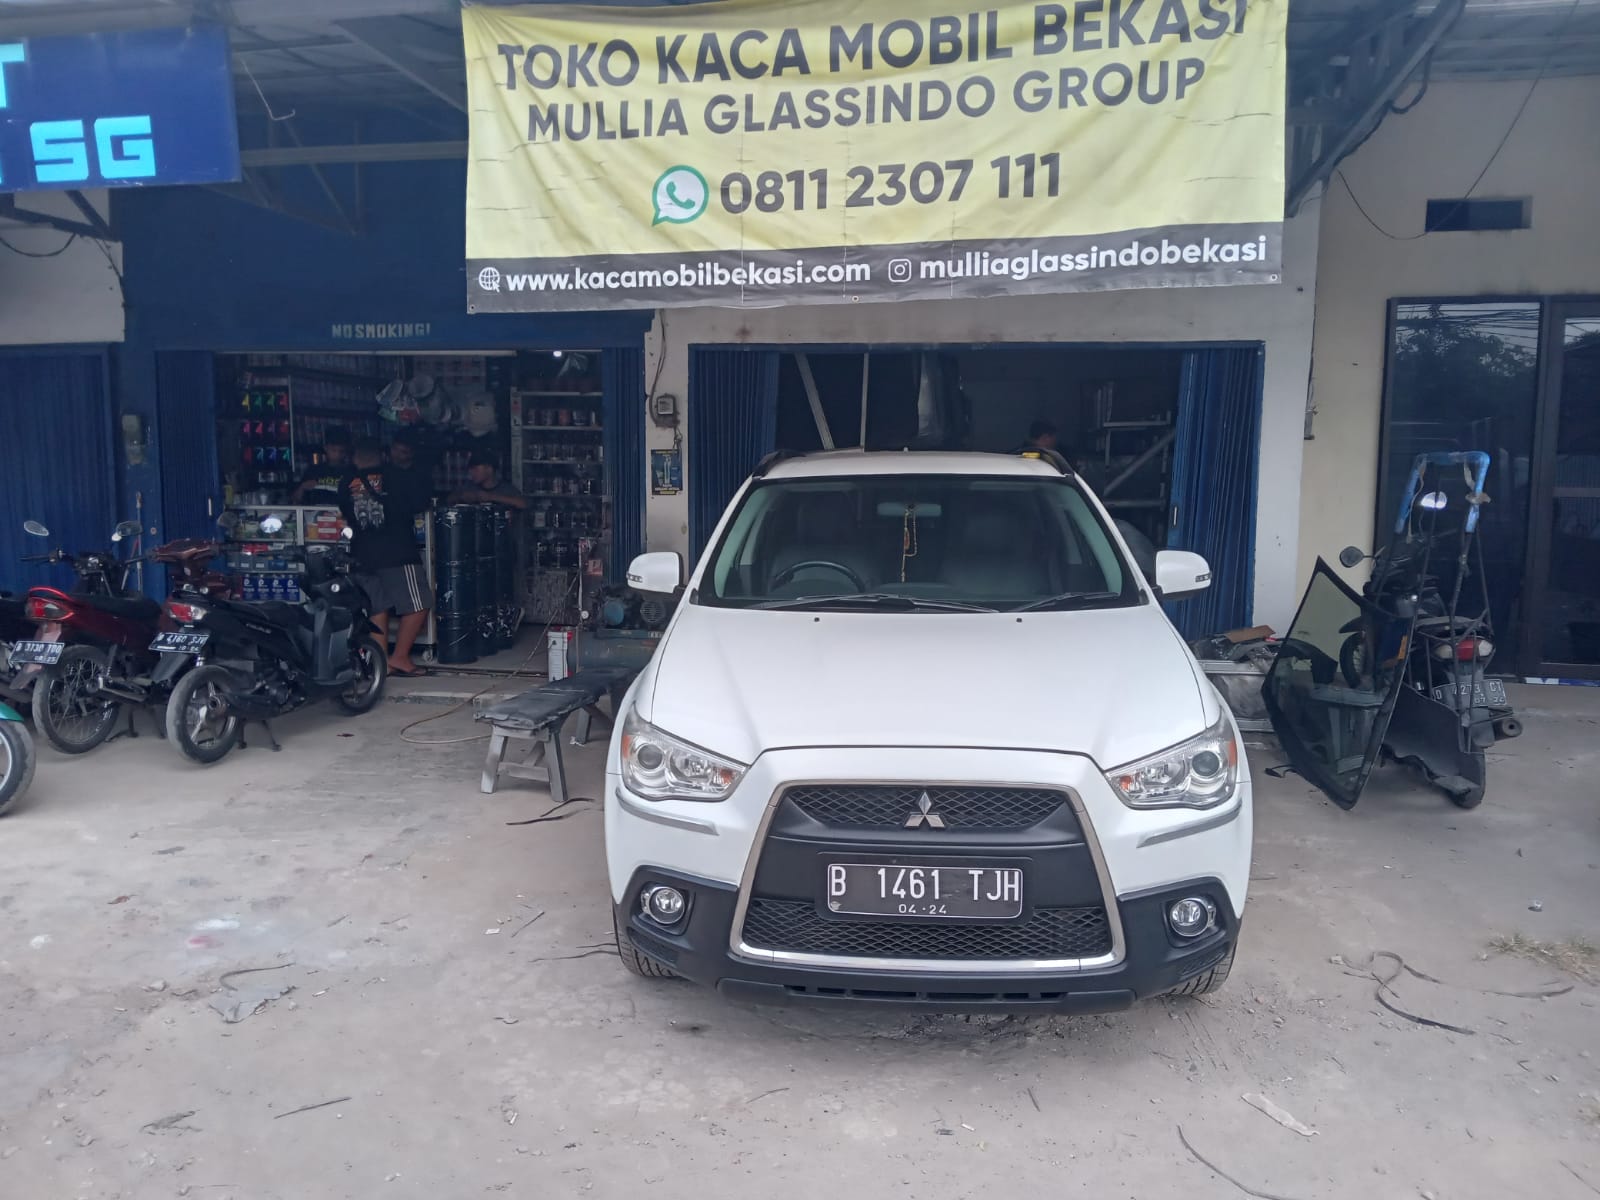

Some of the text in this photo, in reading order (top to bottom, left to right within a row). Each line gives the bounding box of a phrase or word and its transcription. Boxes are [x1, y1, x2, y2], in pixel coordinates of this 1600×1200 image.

[498, 0, 1248, 90] TOKO KACA MOBIL BEKASI
[528, 57, 1205, 142] MULLIA GLASSINDO GROUP
[30, 115, 156, 182] SG
[720, 152, 1060, 214] 0811 2307 111
[506, 260, 871, 291] www.kacamobilbekasi.com
[920, 235, 1266, 280] mulliaglassindobekasi
[831, 866, 1019, 901] B 1461 TJH
